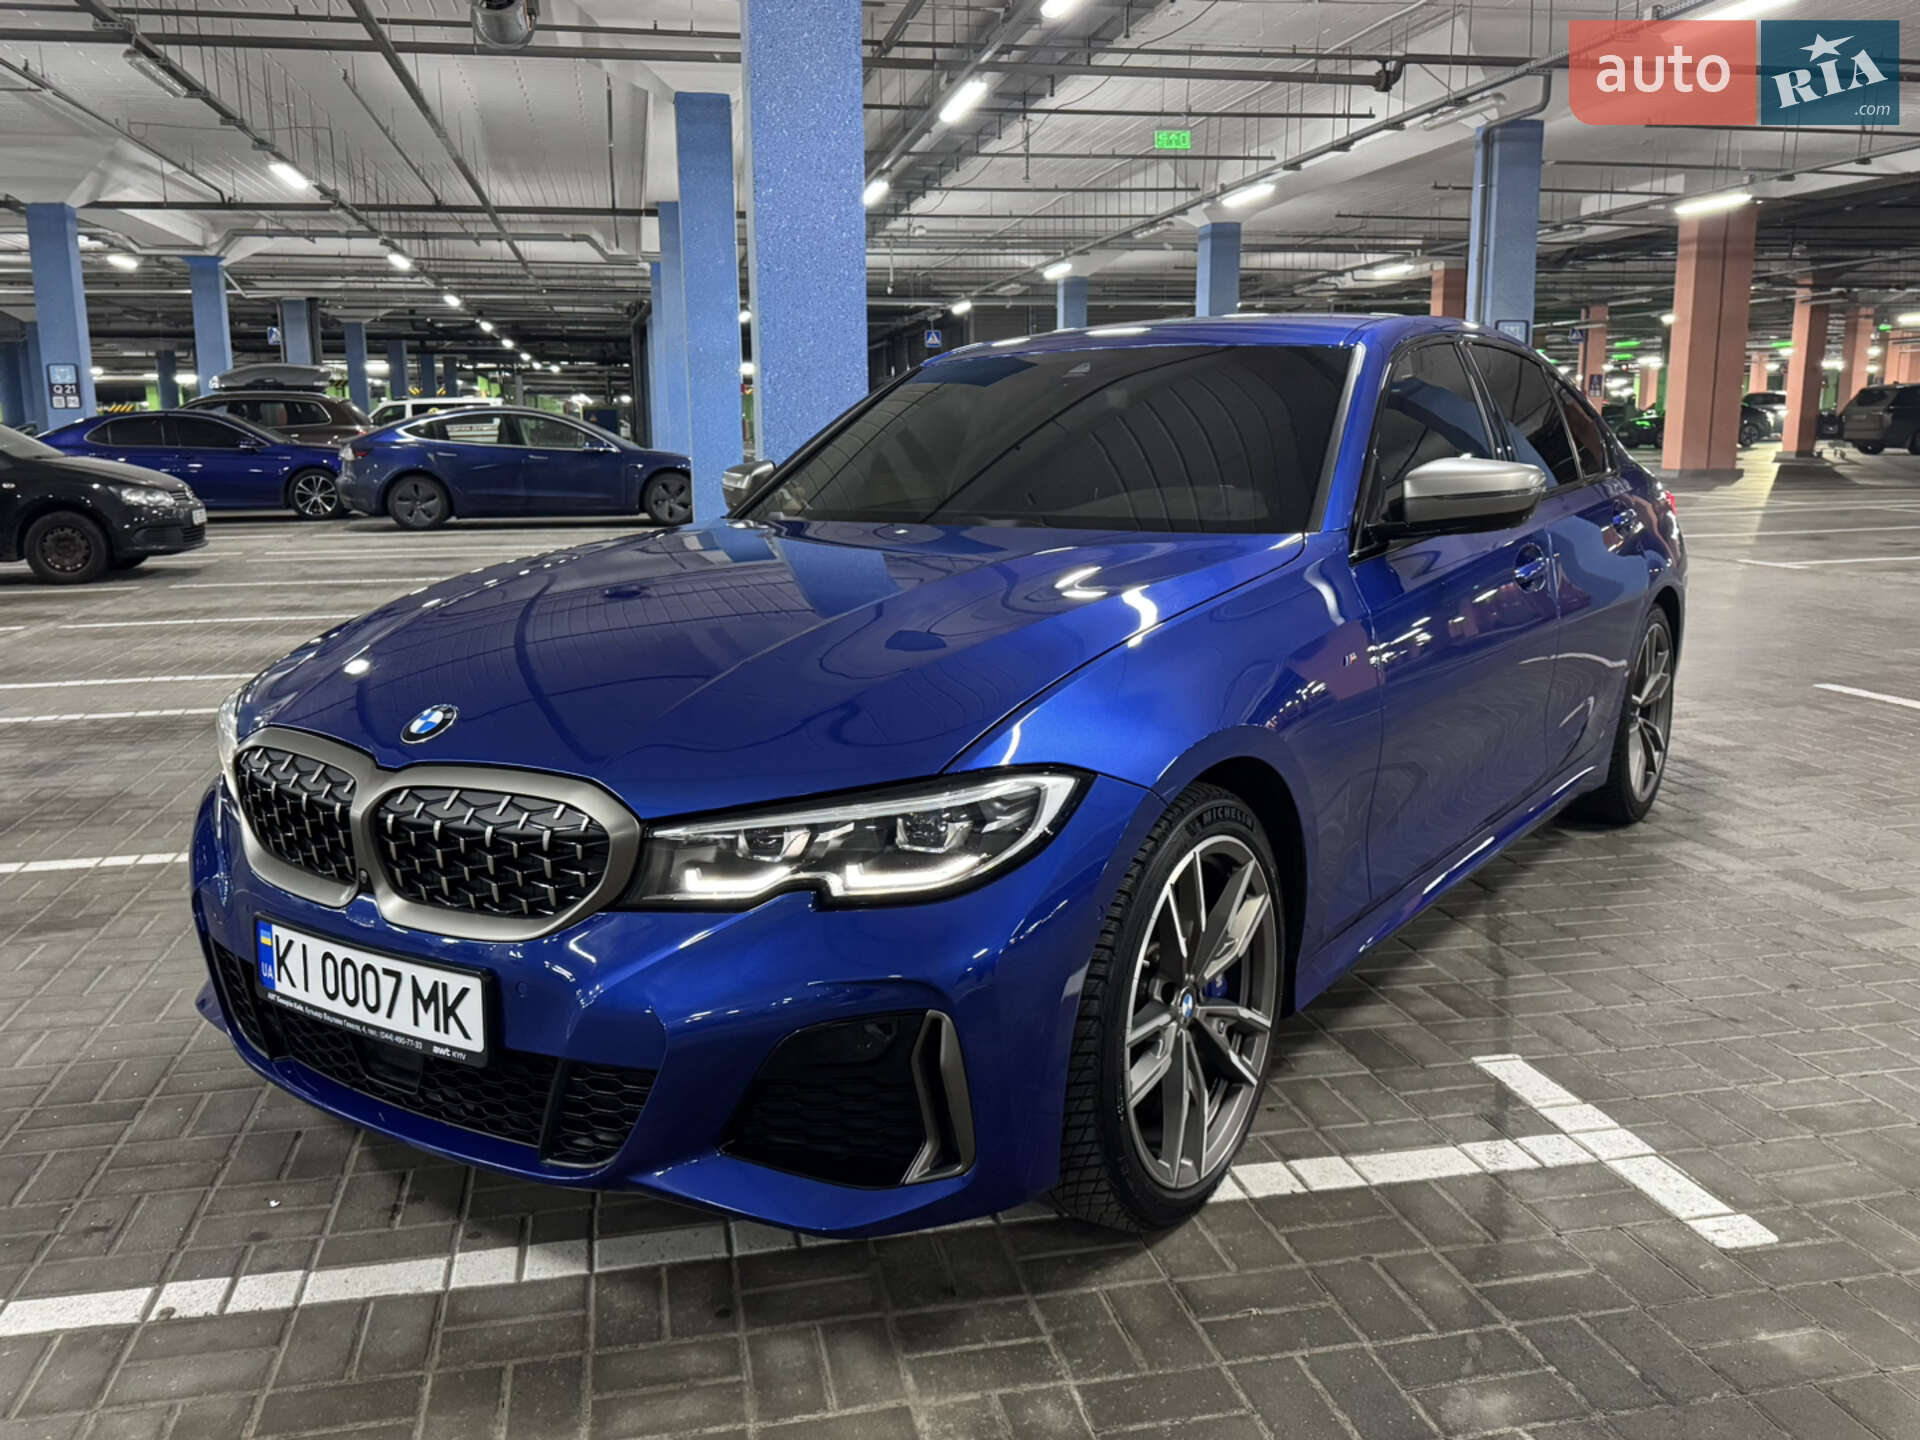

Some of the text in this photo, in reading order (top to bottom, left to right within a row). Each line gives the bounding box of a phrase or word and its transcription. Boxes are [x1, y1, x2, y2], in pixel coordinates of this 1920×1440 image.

[1202, 806, 1253, 829] MICHELIN
[261, 962, 275, 980] UA
[321, 951, 403, 1019] 0007
[411, 974, 473, 1041] MK
